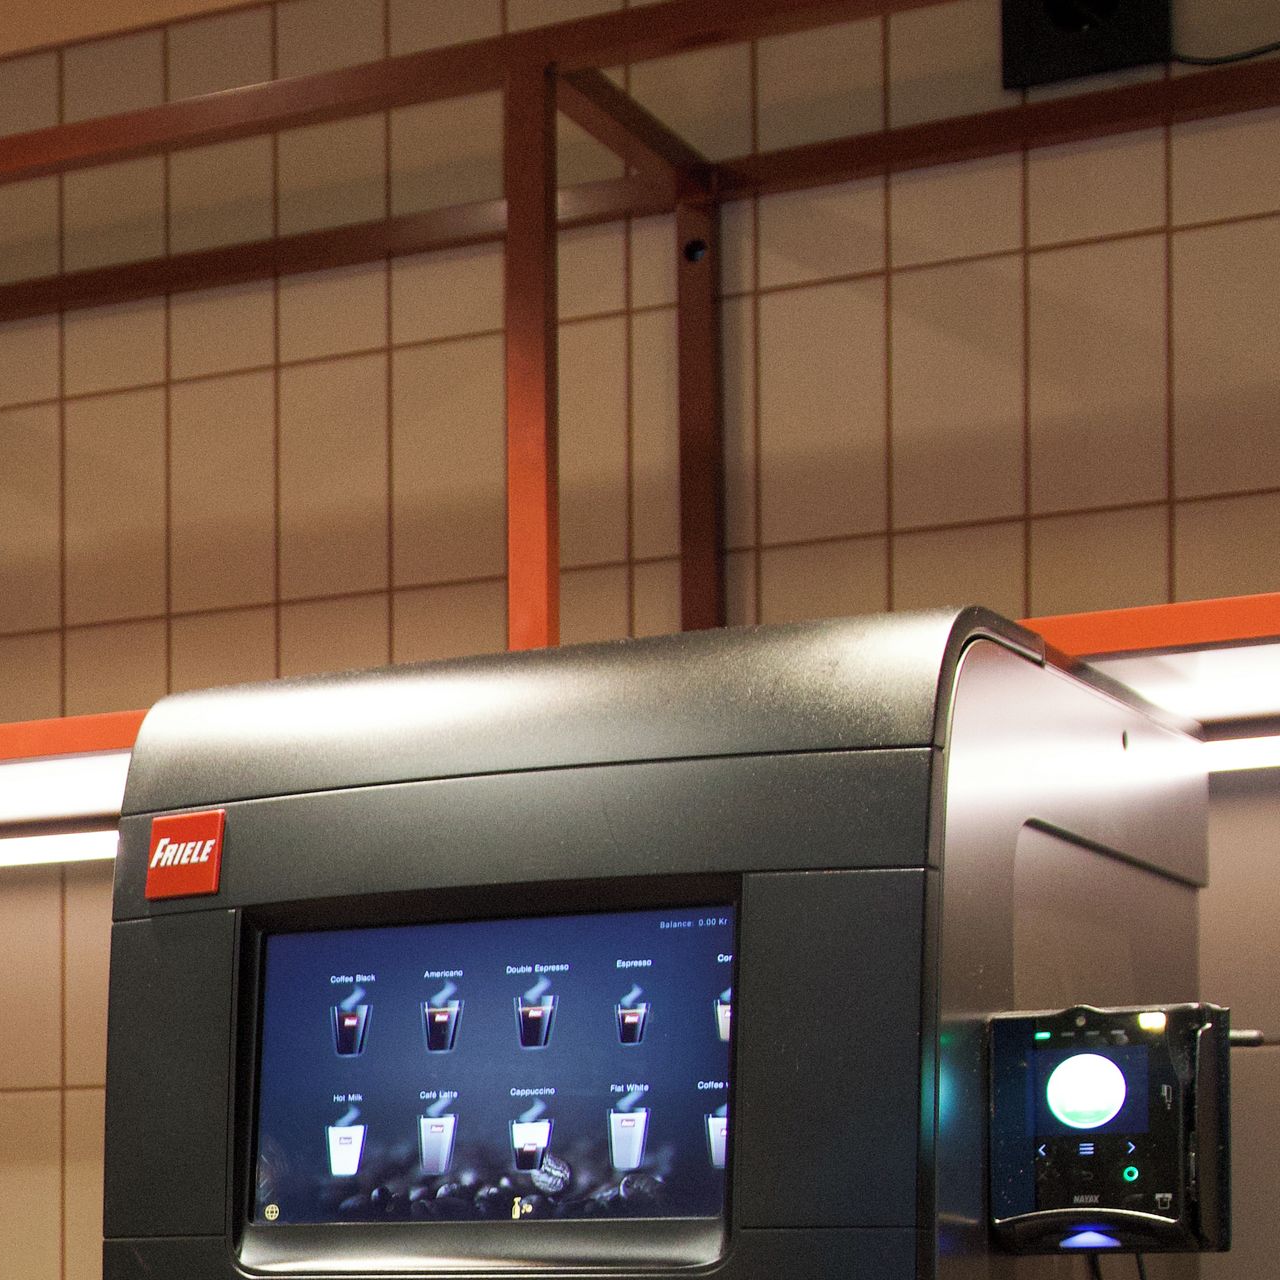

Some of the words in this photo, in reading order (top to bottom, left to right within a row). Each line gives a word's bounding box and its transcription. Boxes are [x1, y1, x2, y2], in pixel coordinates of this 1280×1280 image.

[150, 838, 215, 868] FRIELE
[506, 965, 532, 974] Double
[534, 963, 570, 973] Espresso
[616, 959, 652, 969] Espresso
[330, 975, 354, 984] Coffee
[355, 973, 376, 983] Black
[423, 969, 463, 979] Americano
[610, 1084, 624, 1093] Flat
[626, 1083, 650, 1092] White
[697, 1080, 724, 1090] Coffee
[419, 1090, 437, 1100] Café
[439, 1090, 459, 1099] Latte
[510, 1087, 556, 1097] Cappuccino
[333, 1094, 346, 1103] Hot
[348, 1093, 363, 1102] Milk
